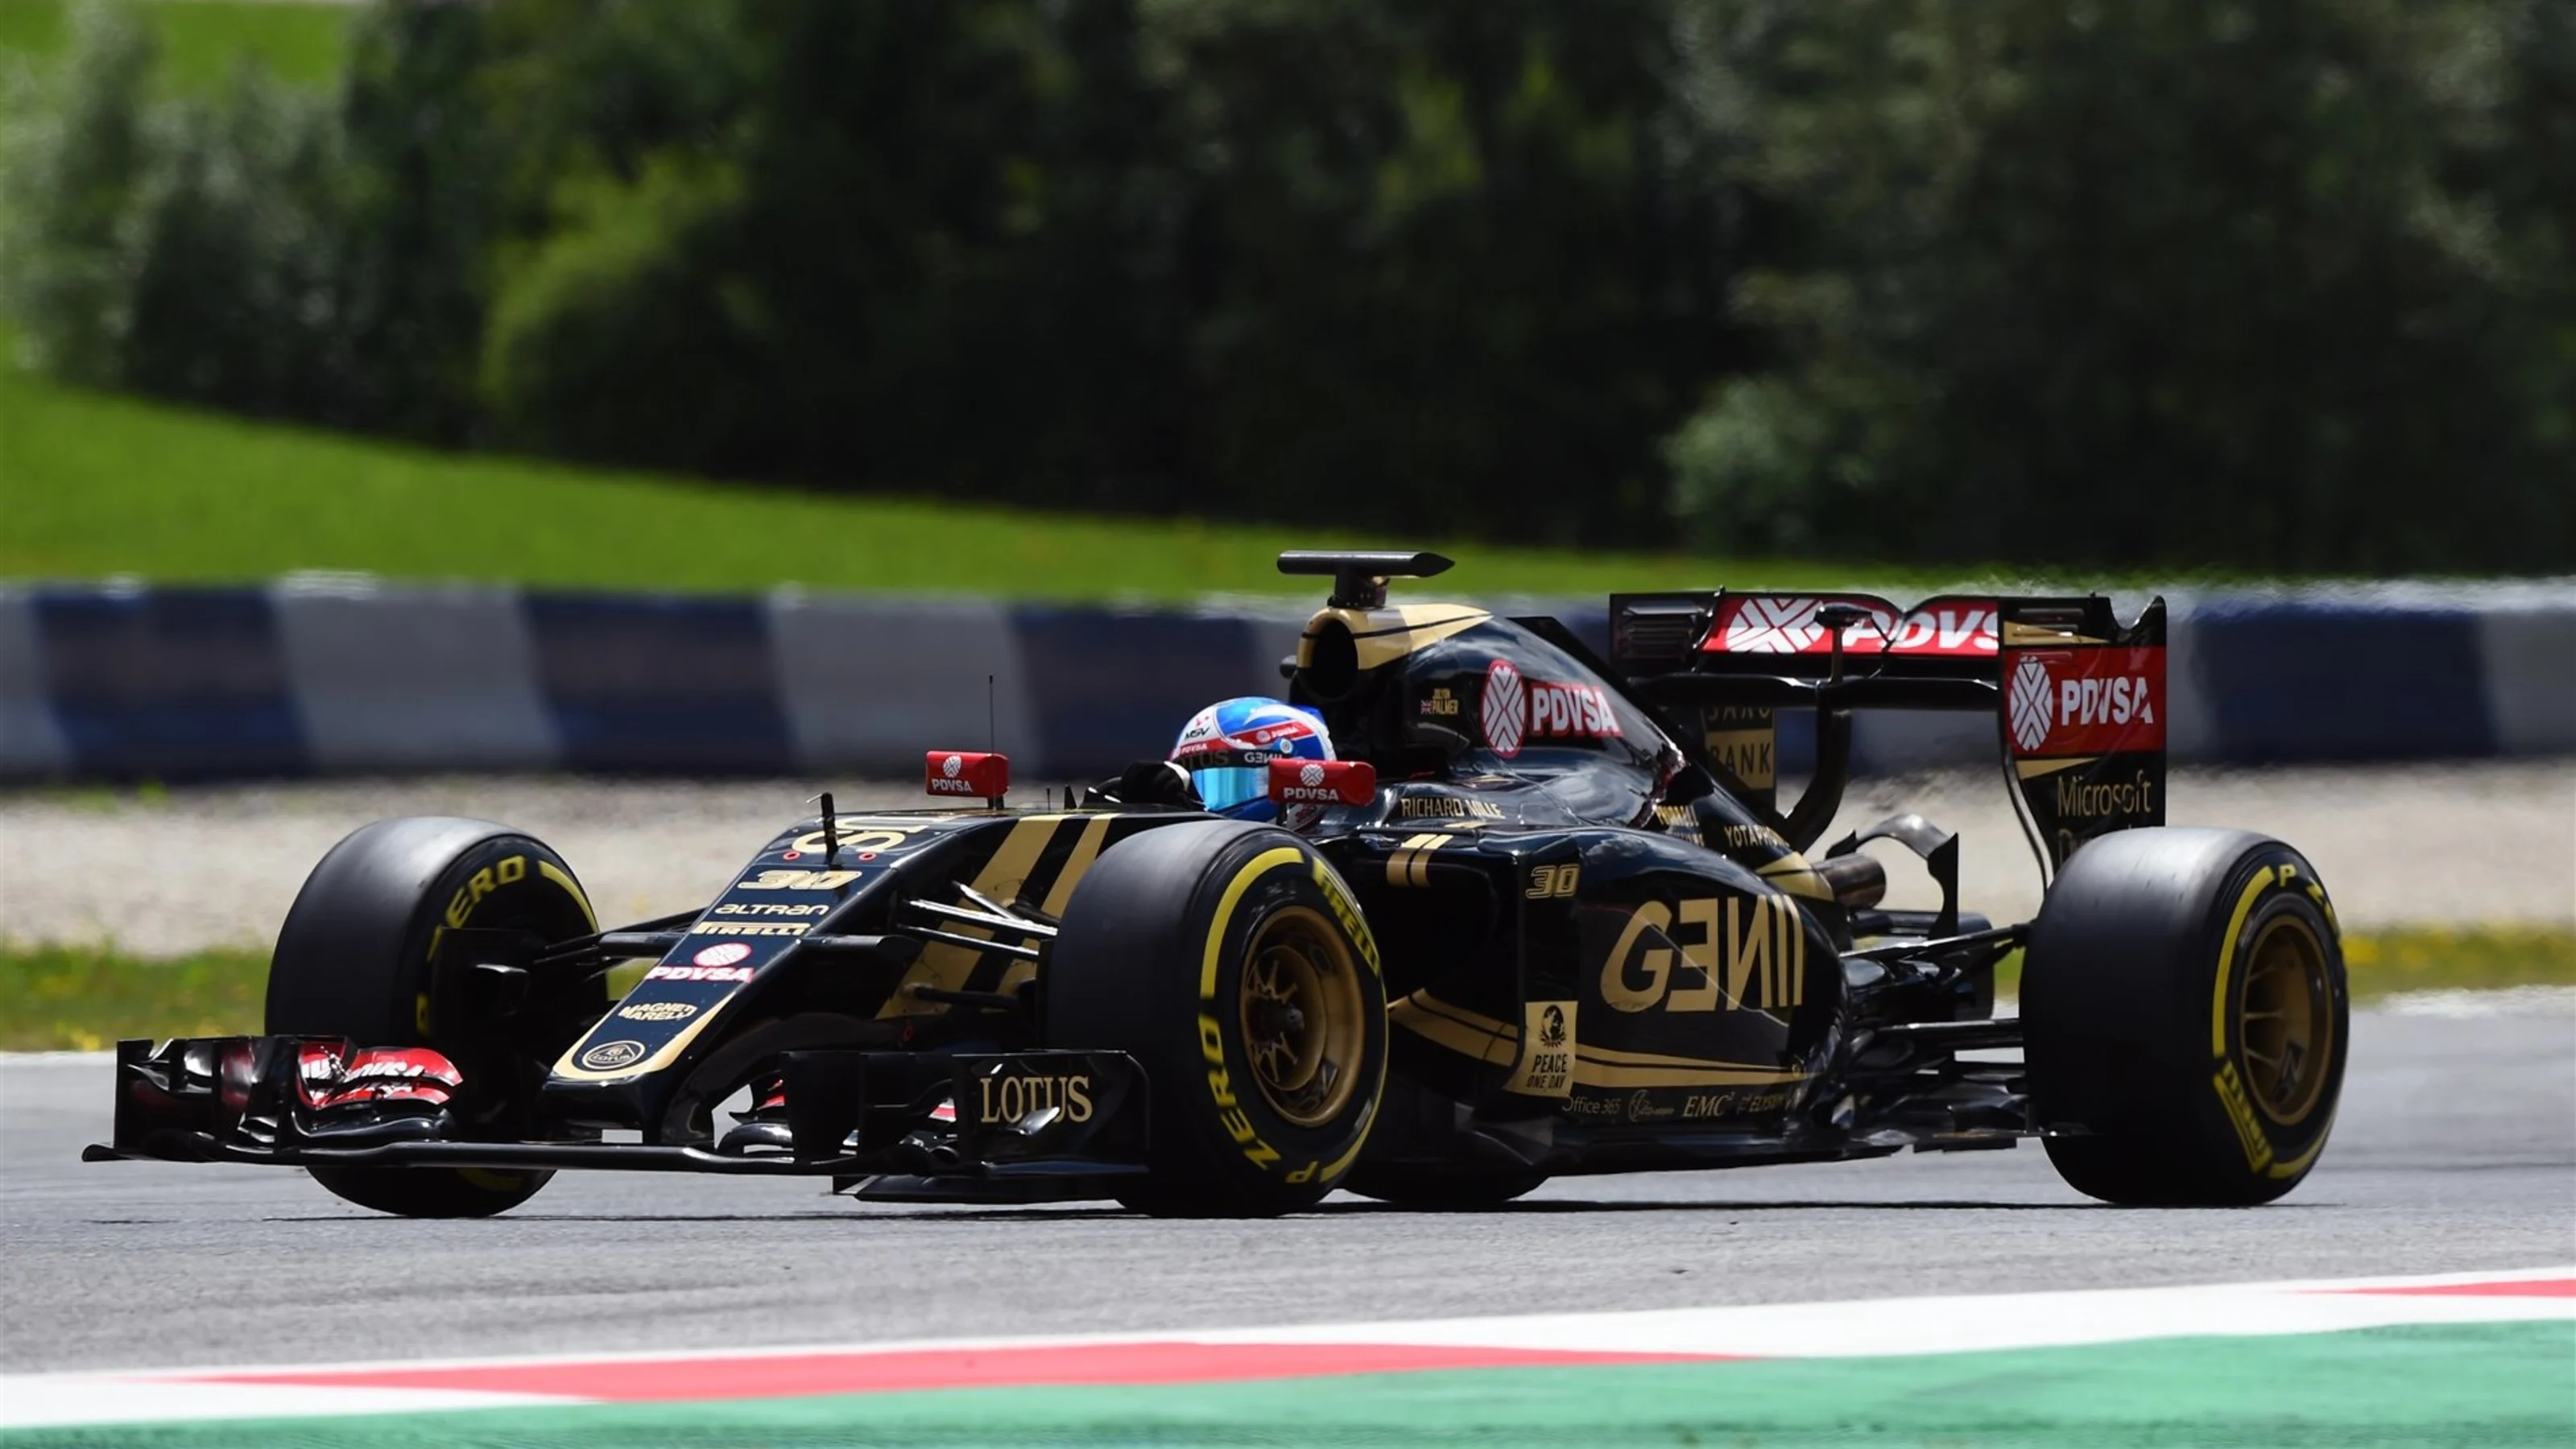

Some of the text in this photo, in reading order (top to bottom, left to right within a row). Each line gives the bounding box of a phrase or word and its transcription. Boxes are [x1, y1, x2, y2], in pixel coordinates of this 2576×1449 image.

[1842, 609, 1999, 650] PDVS
[1532, 687, 1620, 734] PDVSA
[2061, 677, 2154, 725] PDVSA
[931, 778, 973, 792] PDVSA
[1283, 787, 1339, 801] PDVSA
[2057, 770, 2152, 818] Microsoft
[1400, 798, 1465, 818] RICHARD
[737, 869, 863, 890] 30
[1526, 864, 1580, 899] 30
[691, 923, 812, 935] PIRELLI
[646, 967, 755, 983] PDVSA
[1532, 1054, 1568, 1074] PEACE
[1197, 1013, 1281, 1170] ZERO
[1527, 1074, 1565, 1090] ONE DAY
[980, 1075, 1094, 1123] LOTUS
[1602, 1097, 1622, 1116] 365
